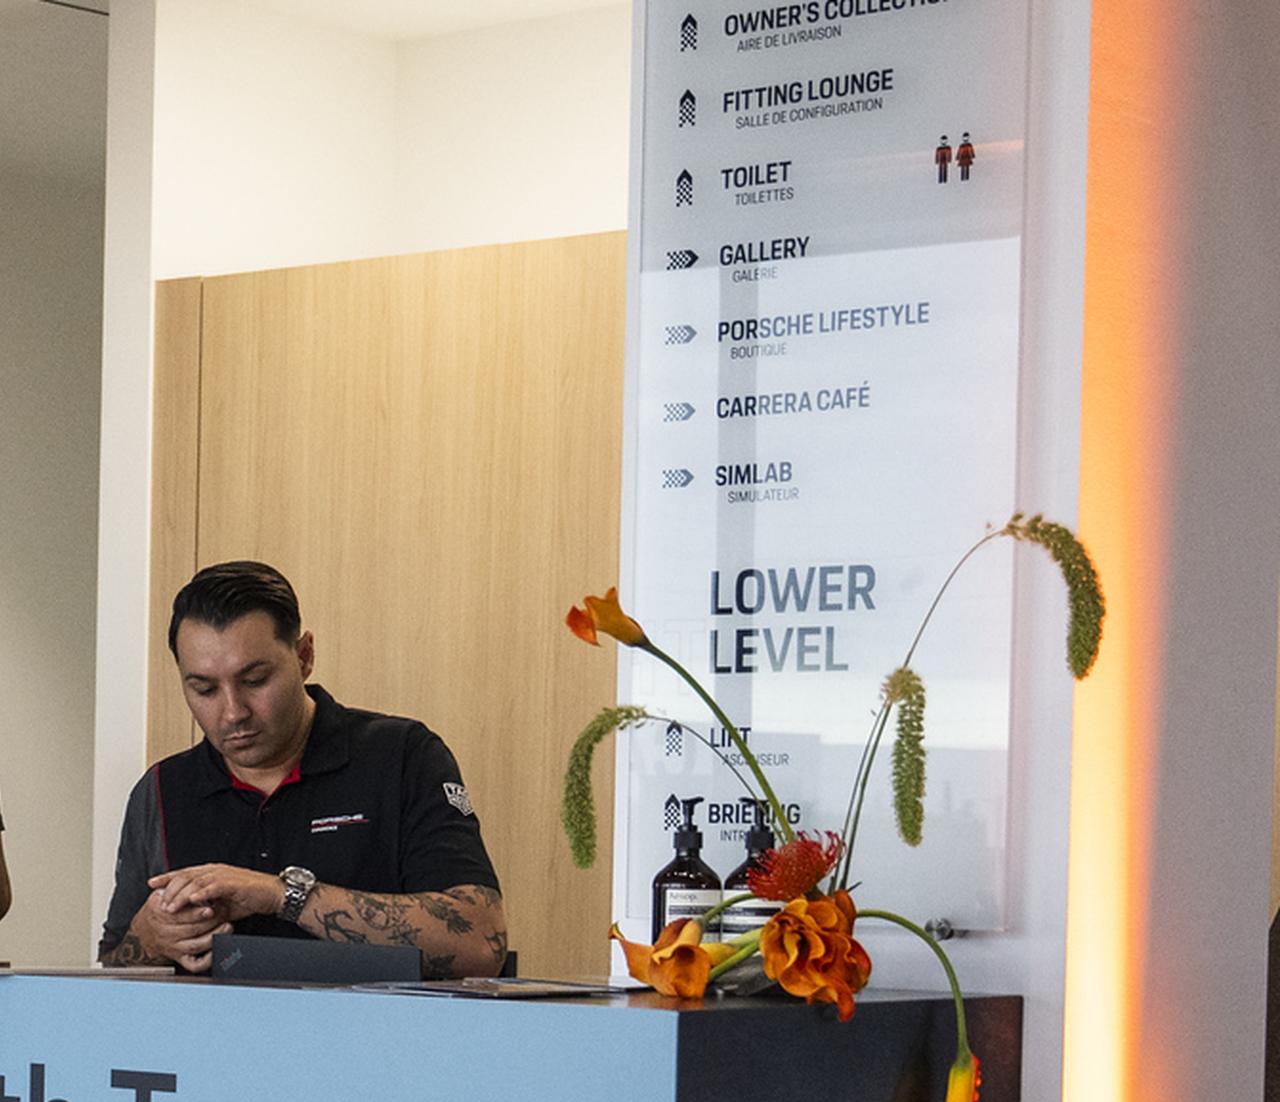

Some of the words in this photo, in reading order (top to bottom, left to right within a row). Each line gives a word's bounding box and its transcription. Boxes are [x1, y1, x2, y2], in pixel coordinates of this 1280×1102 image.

[724, 1, 820, 37] OWNER'S
[737, 35, 761, 53] AIRE
[764, 32, 778, 48] DE
[781, 25, 842, 46] LIVRAISON
[723, 82, 803, 113] FITTING
[808, 69, 894, 100] LOUNGE
[735, 112, 769, 130] SALLE
[772, 111, 787, 124] DE
[789, 98, 883, 122] CONFIGURATION
[721, 161, 792, 190] TOILET
[735, 187, 794, 206] TOILETTES
[720, 236, 810, 267] GALLERY
[718, 312, 814, 343] PORSCHE
[819, 302, 930, 333] LIFESTYLE
[730, 342, 788, 361] BOUTIQUE
[716, 389, 813, 419] CARRERA
[817, 381, 870, 411] CAFÉ
[715, 461, 793, 487] SIMLAB
[728, 486, 800, 504] SIMULATEUR
[710, 564, 876, 616] LOWER
[709, 626, 849, 674] LEVEL
